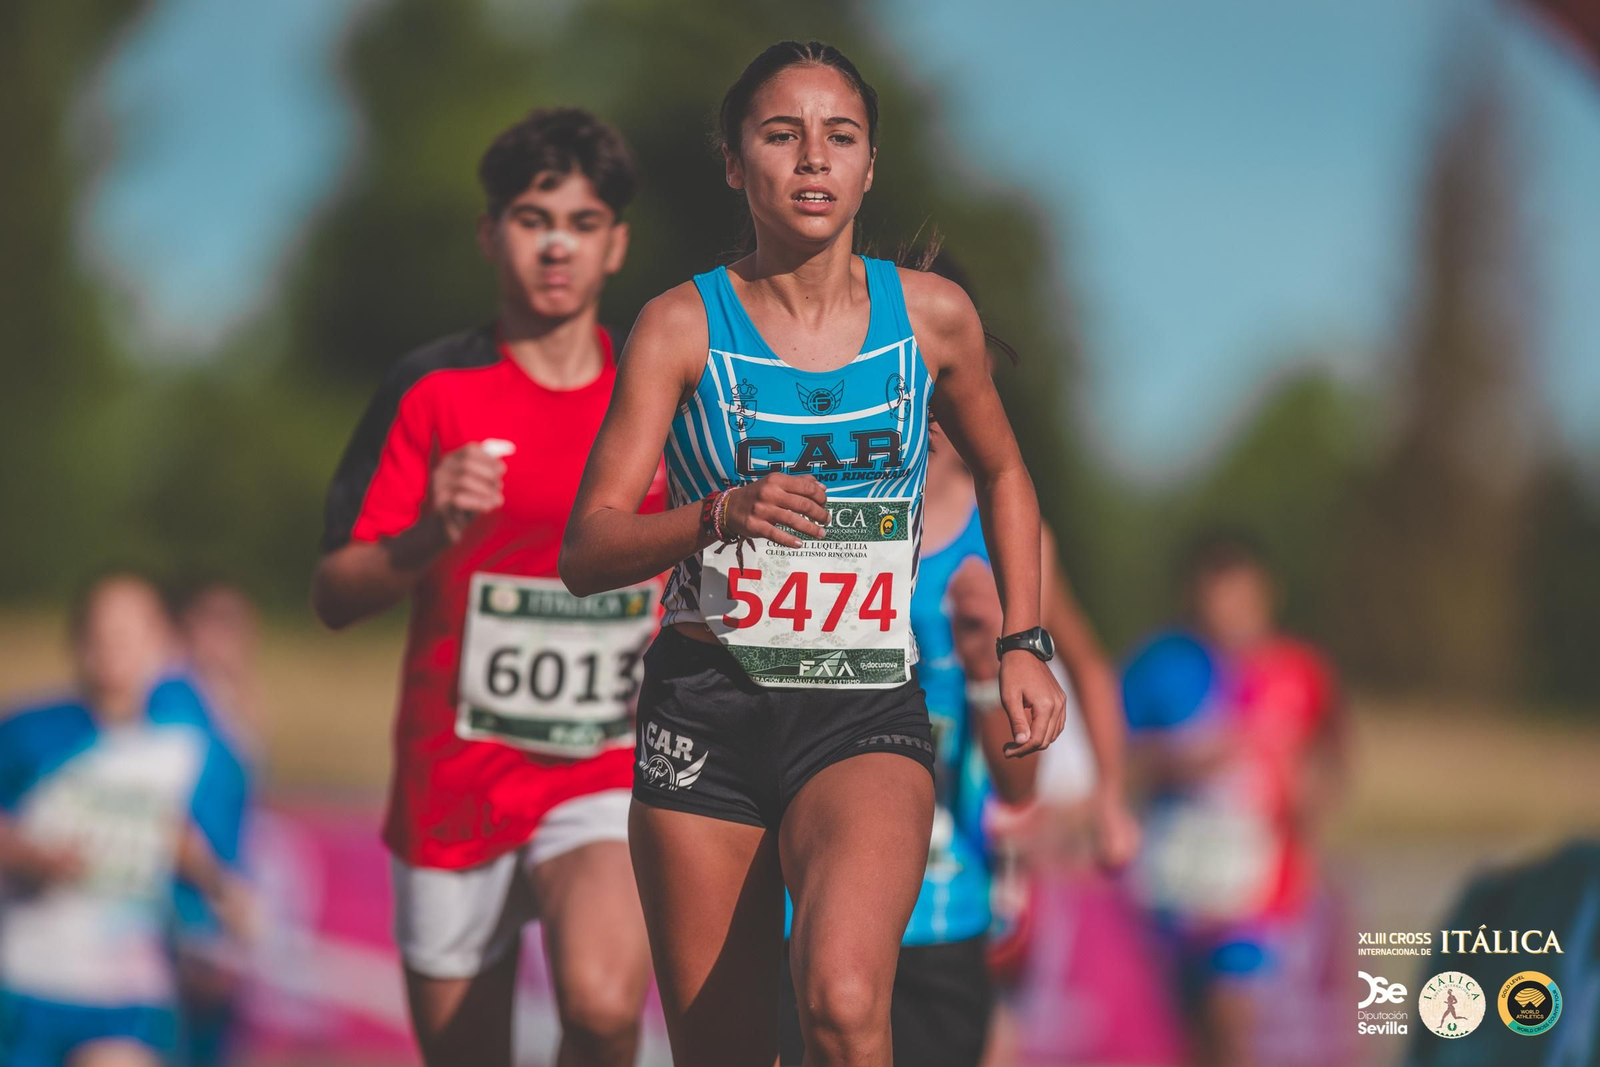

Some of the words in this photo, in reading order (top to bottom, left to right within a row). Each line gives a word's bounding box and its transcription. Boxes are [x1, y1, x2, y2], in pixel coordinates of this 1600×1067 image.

[735, 428, 904, 477] CAR
[841, 468, 911, 481] RINCONADA
[786, 550, 827, 558] ATLETISMO
[827, 551, 868, 559] RINCONADA
[811, 541, 843, 551] LUQUE,
[843, 542, 868, 551] JULIA
[722, 567, 898, 633] 5474
[486, 647, 641, 703] 6013
[867, 661, 898, 669] docunova
[646, 721, 694, 761] CAR
